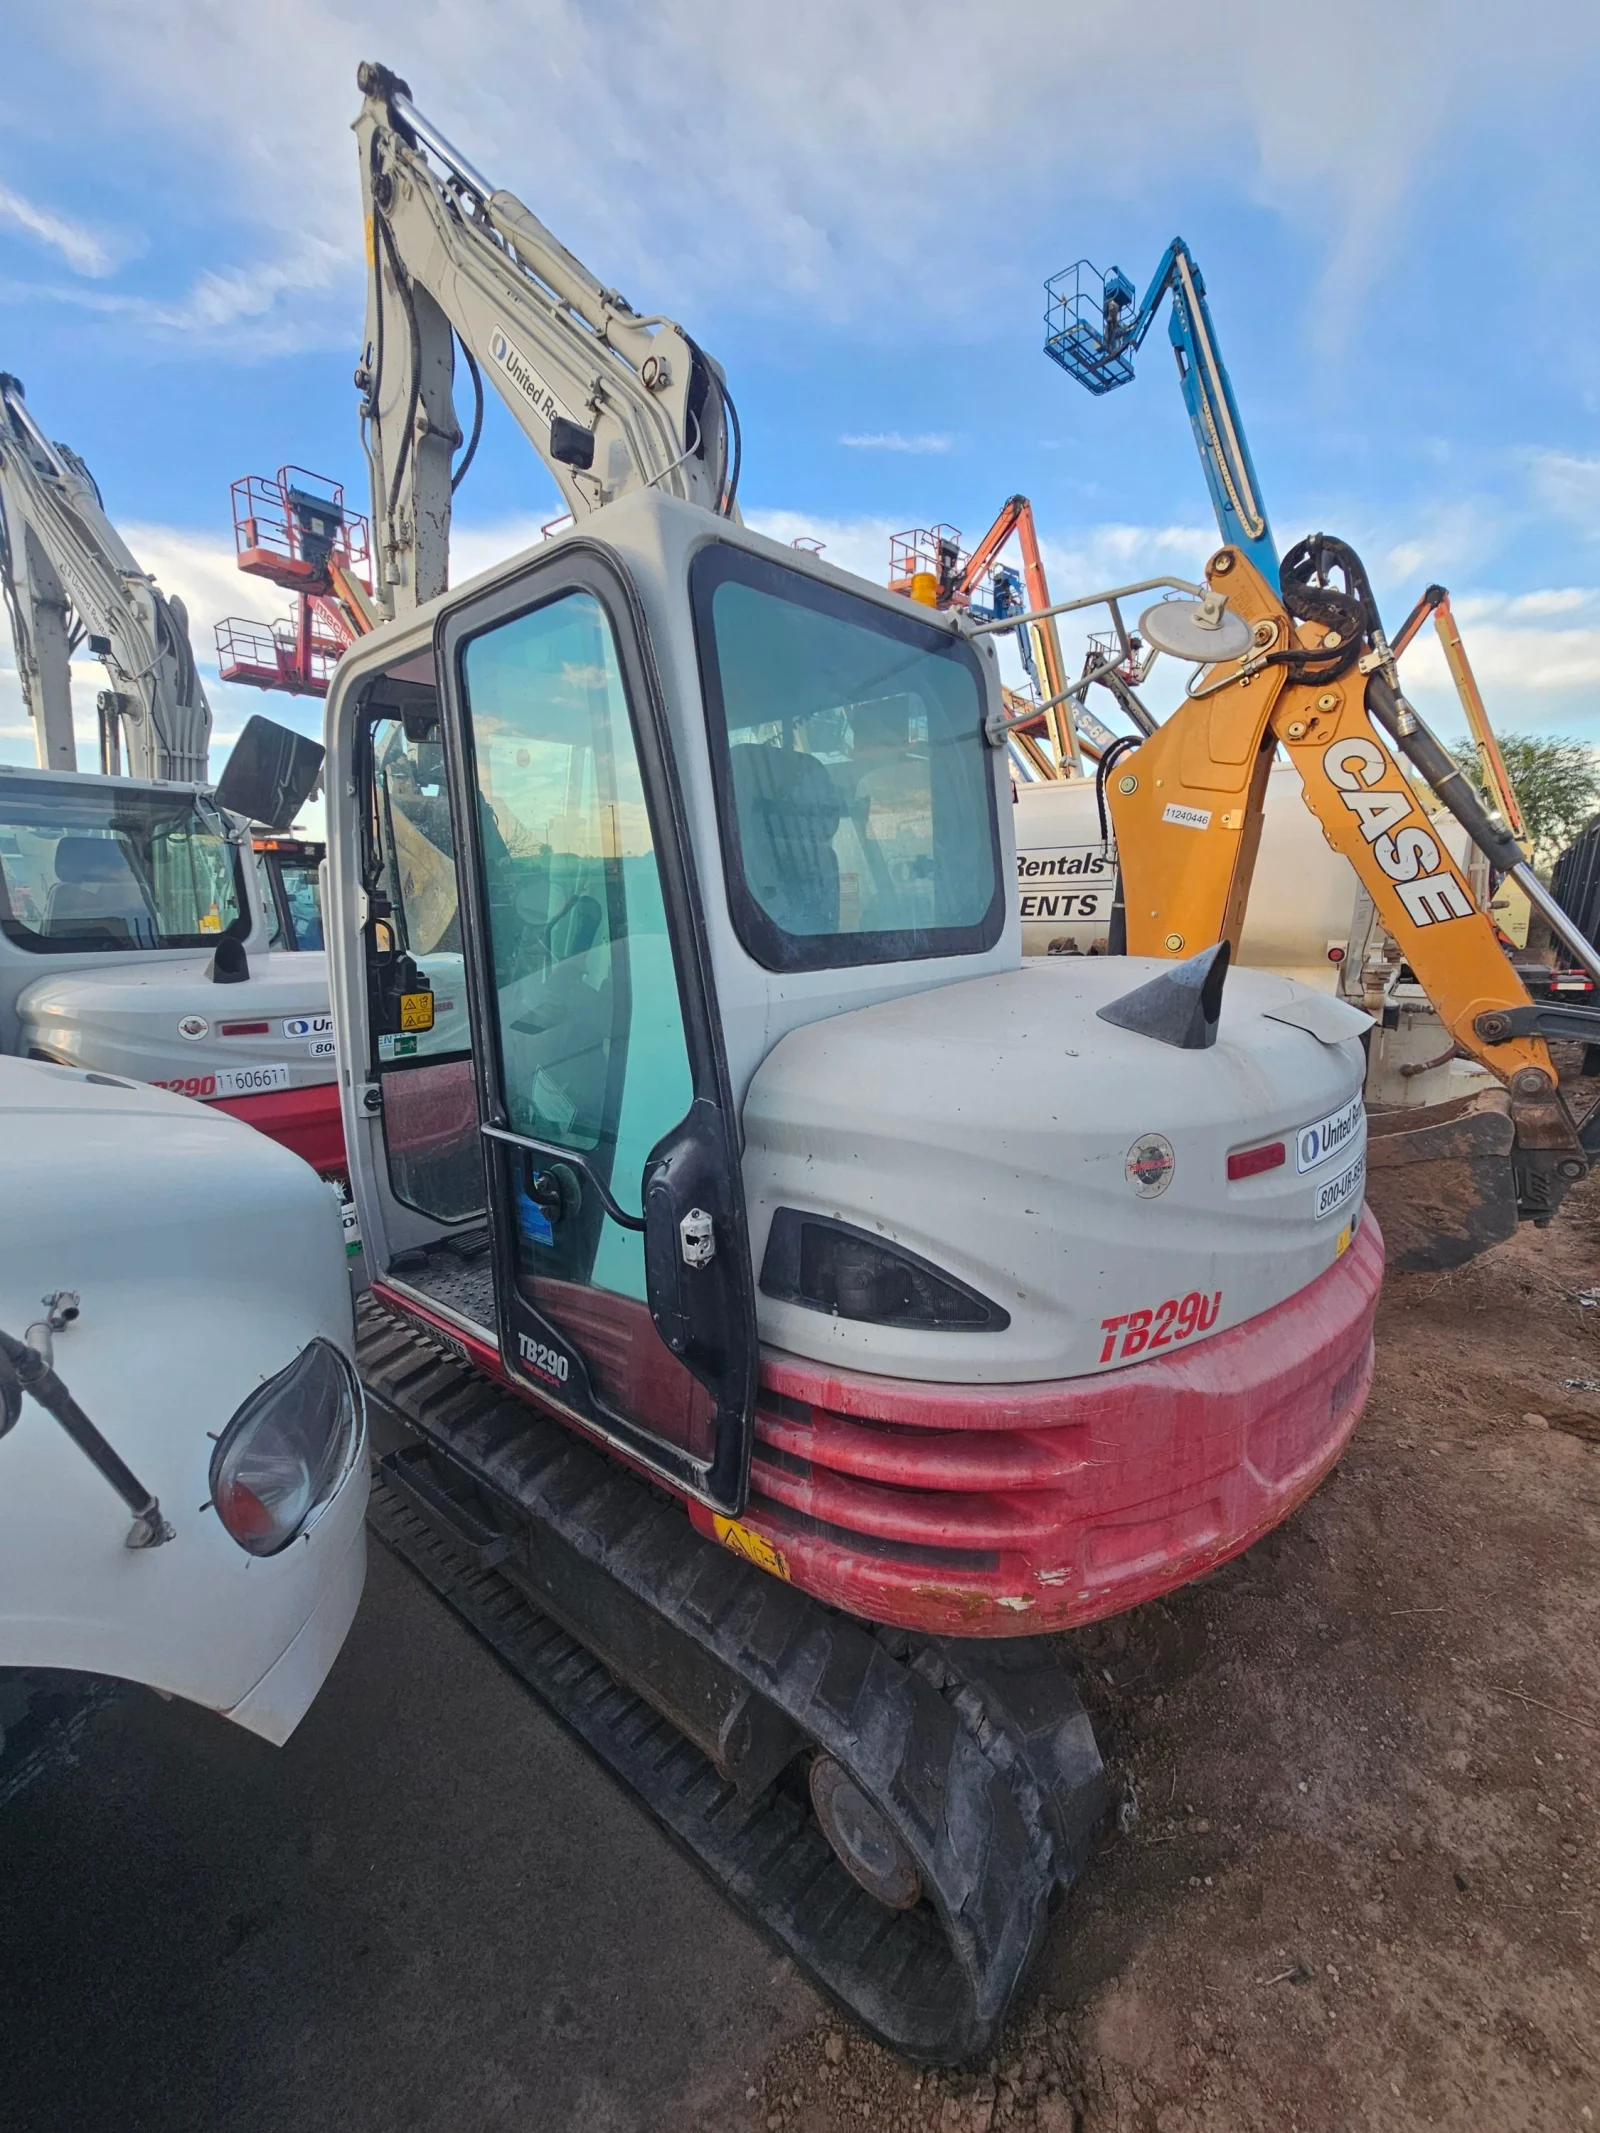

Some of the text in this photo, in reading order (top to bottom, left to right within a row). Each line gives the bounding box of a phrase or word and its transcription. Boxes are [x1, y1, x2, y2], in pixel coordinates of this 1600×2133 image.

[506, 351, 559, 422] United Re
[1166, 807, 1209, 825] 11240446
[1323, 737, 1476, 928] CASE
[1016, 852, 1105, 877] Rentals
[1020, 894, 1098, 917] ENTS
[313, 1019, 333, 1032] Un
[315, 1043, 337, 1054] 80
[149, 1075, 216, 1098] 290
[216, 1068, 287, 1091] 11606611
[1321, 1108, 1352, 1152] United
[518, 1331, 569, 1382] TB290
